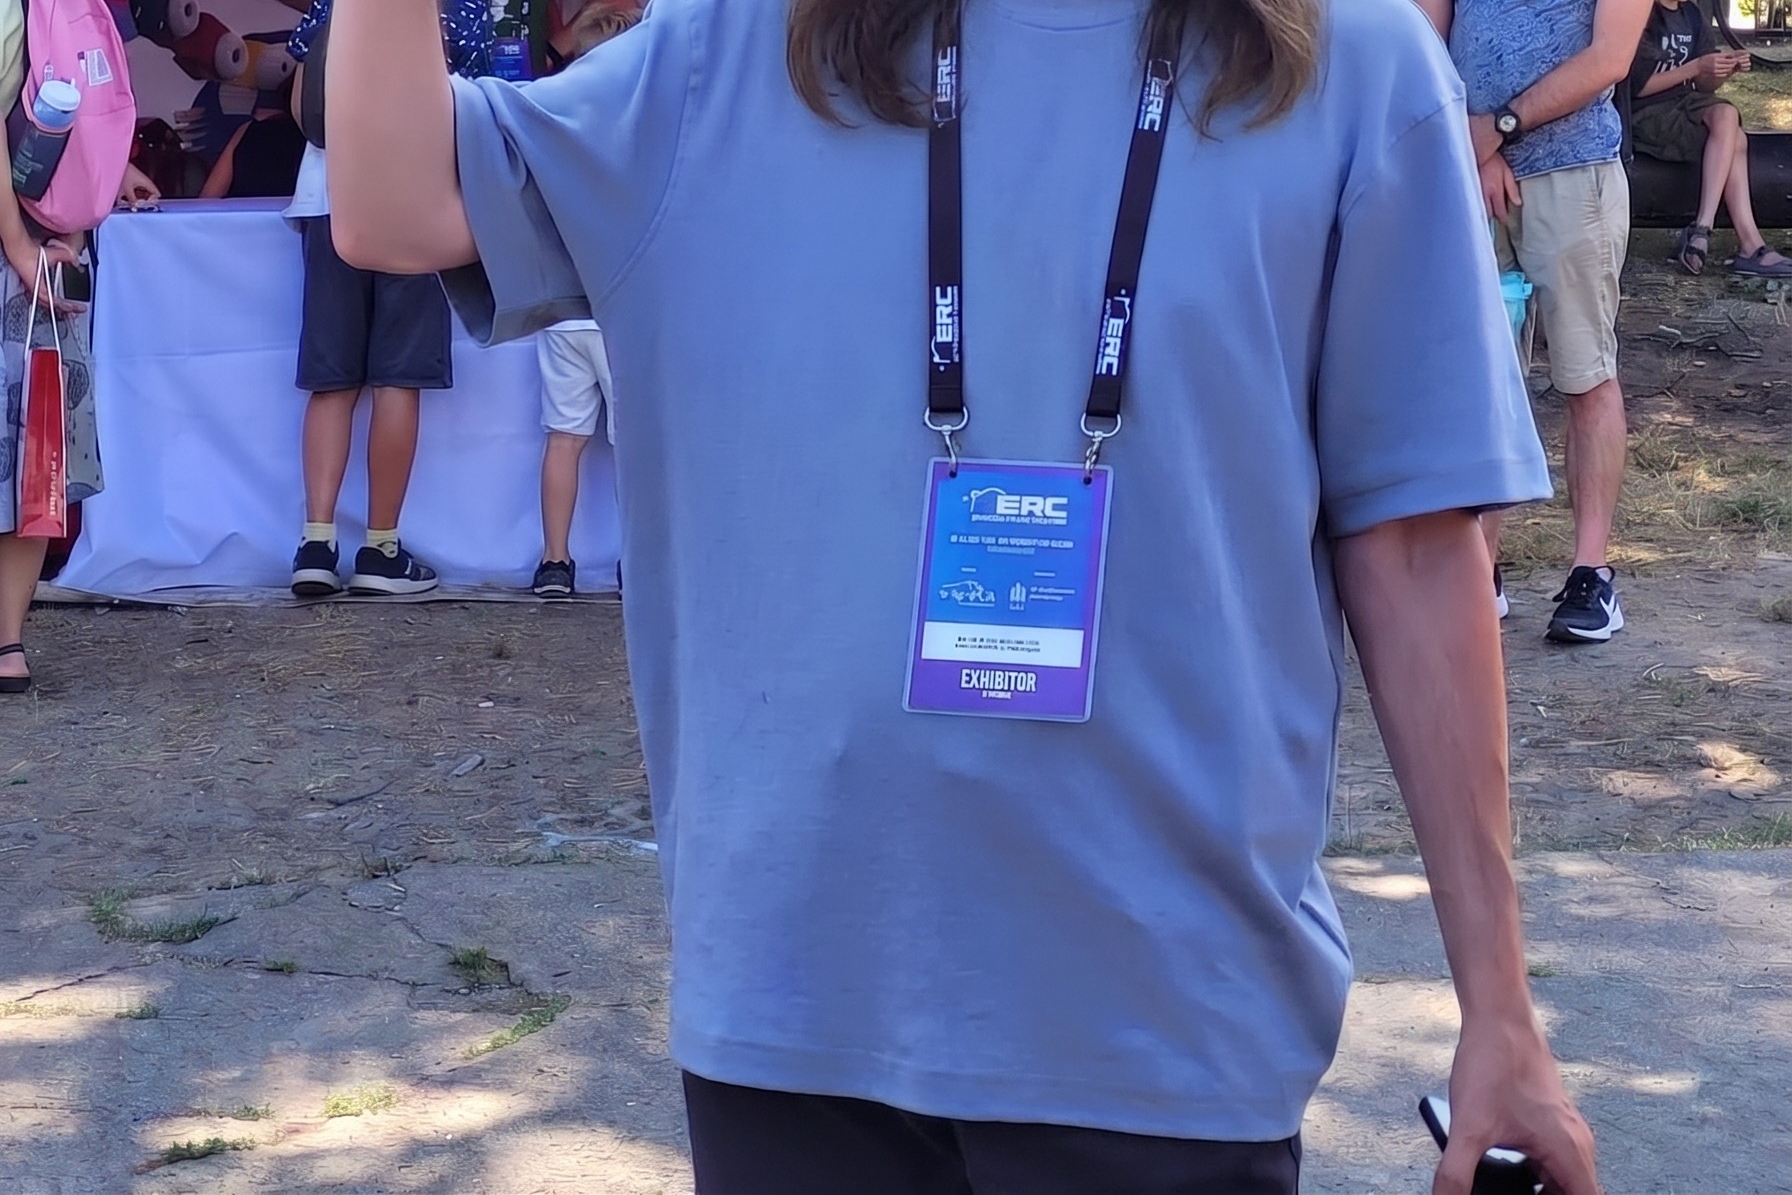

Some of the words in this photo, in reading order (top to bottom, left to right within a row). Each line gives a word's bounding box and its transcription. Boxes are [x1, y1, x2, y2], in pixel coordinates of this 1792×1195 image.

[935, 286, 953, 343] ERC
[1101, 317, 1125, 376] ERC
[996, 494, 1068, 518] ERC
[960, 669, 1037, 693] EXHIBITOR
